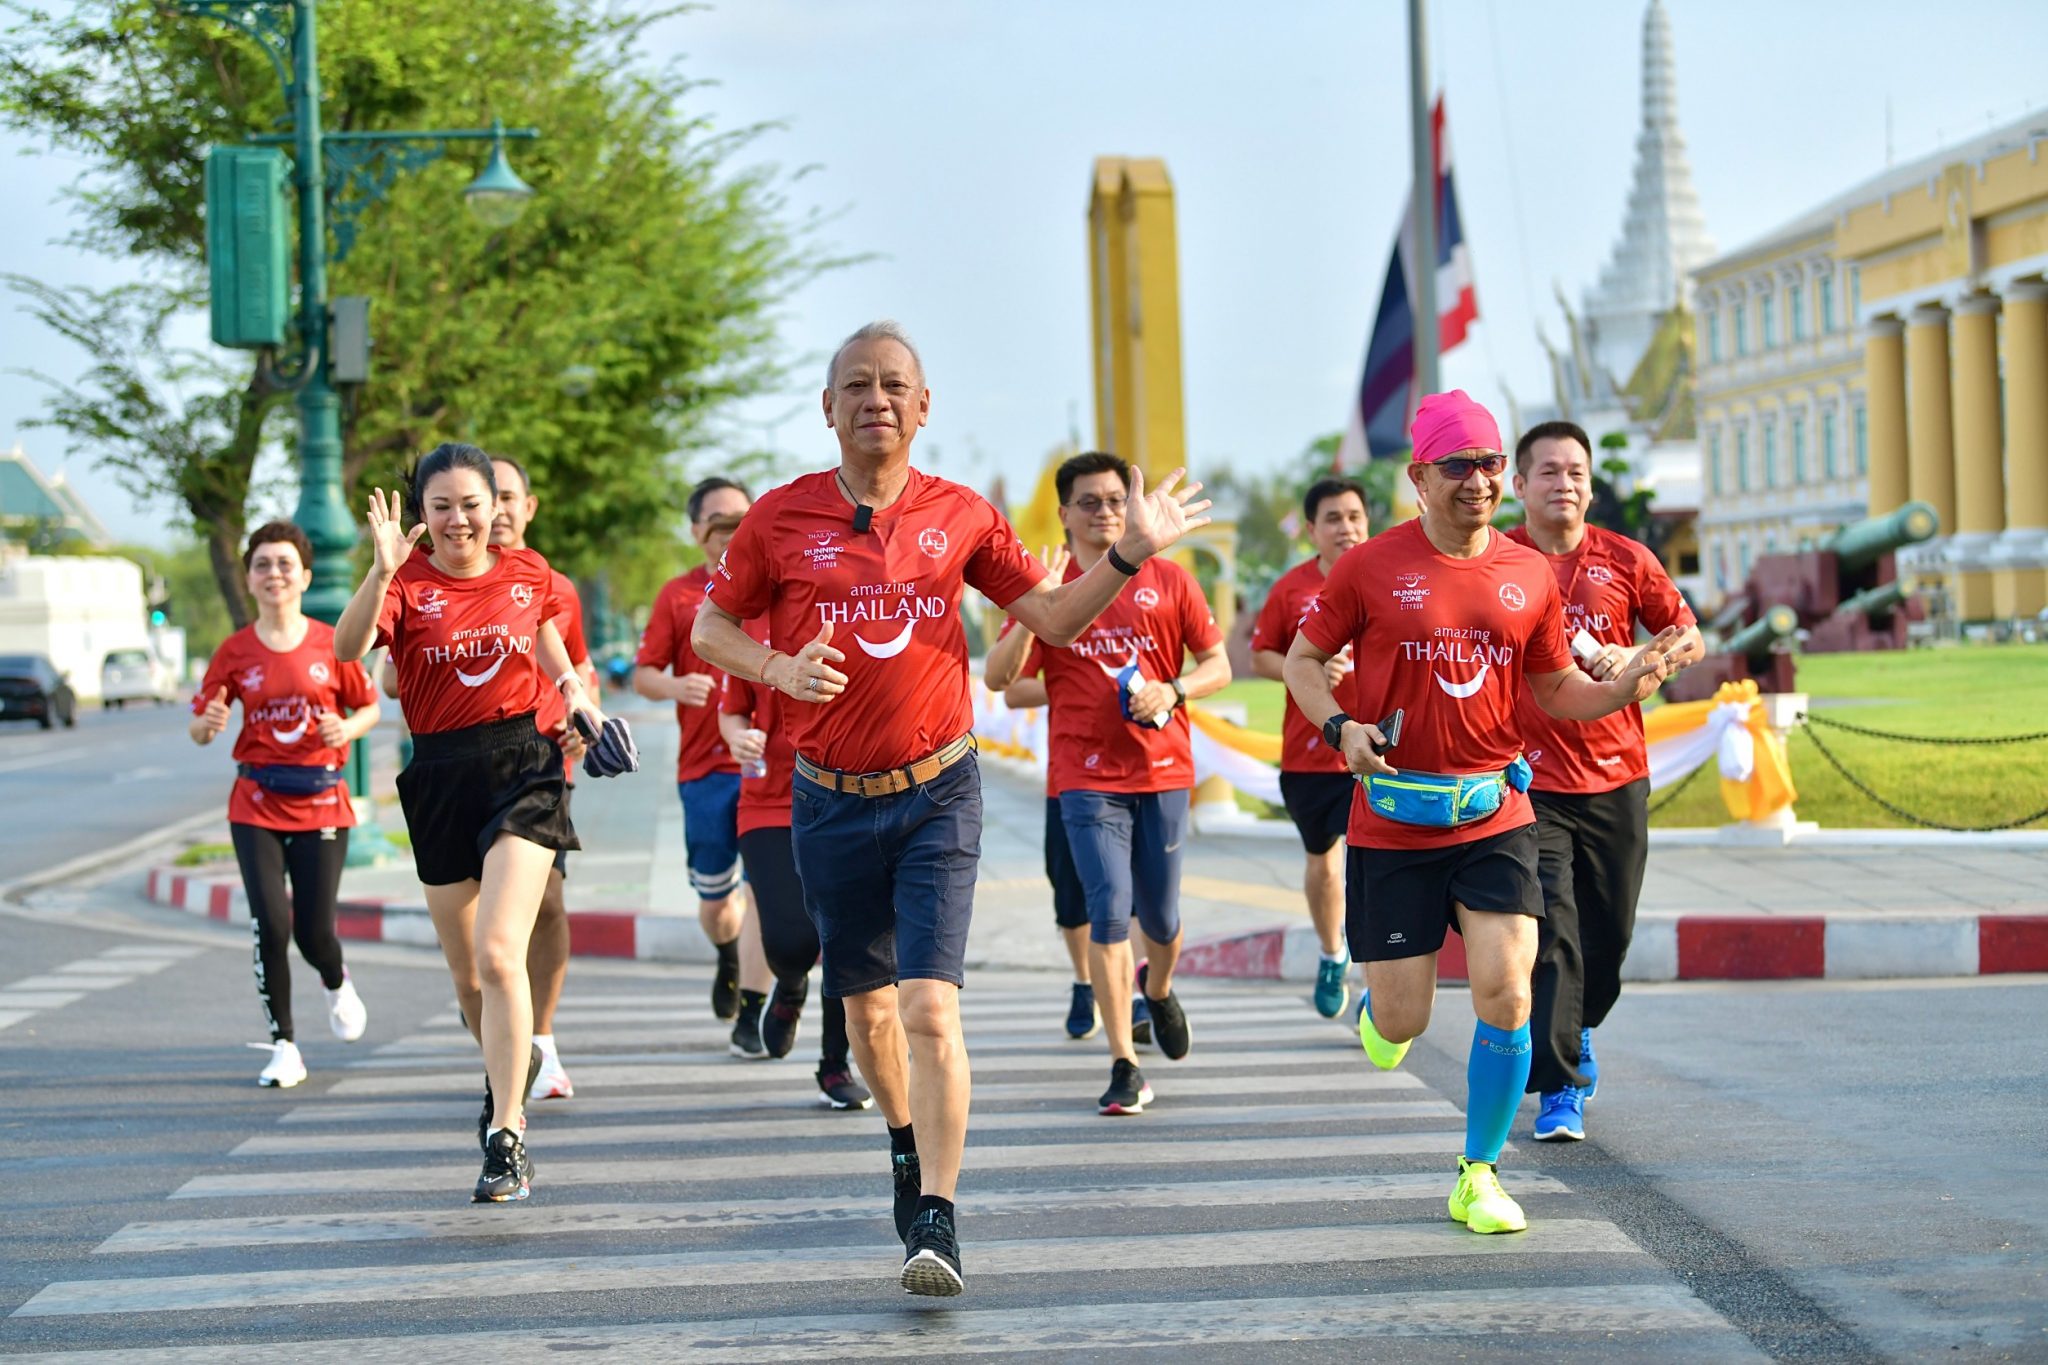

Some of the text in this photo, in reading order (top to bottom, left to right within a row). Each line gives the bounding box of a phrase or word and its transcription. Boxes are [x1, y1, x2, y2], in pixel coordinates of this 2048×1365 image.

[803, 546, 844, 558] RUNNING
[813, 552, 837, 562] ZONE
[850, 580, 916, 597] amazing
[1392, 589, 1430, 597] RUNNING
[815, 596, 946, 624] THAILAND
[452, 624, 509, 641] amazing
[1434, 626, 1491, 644] amazing
[422, 636, 532, 665] THAILAND
[1400, 641, 1513, 667] THAILAND
